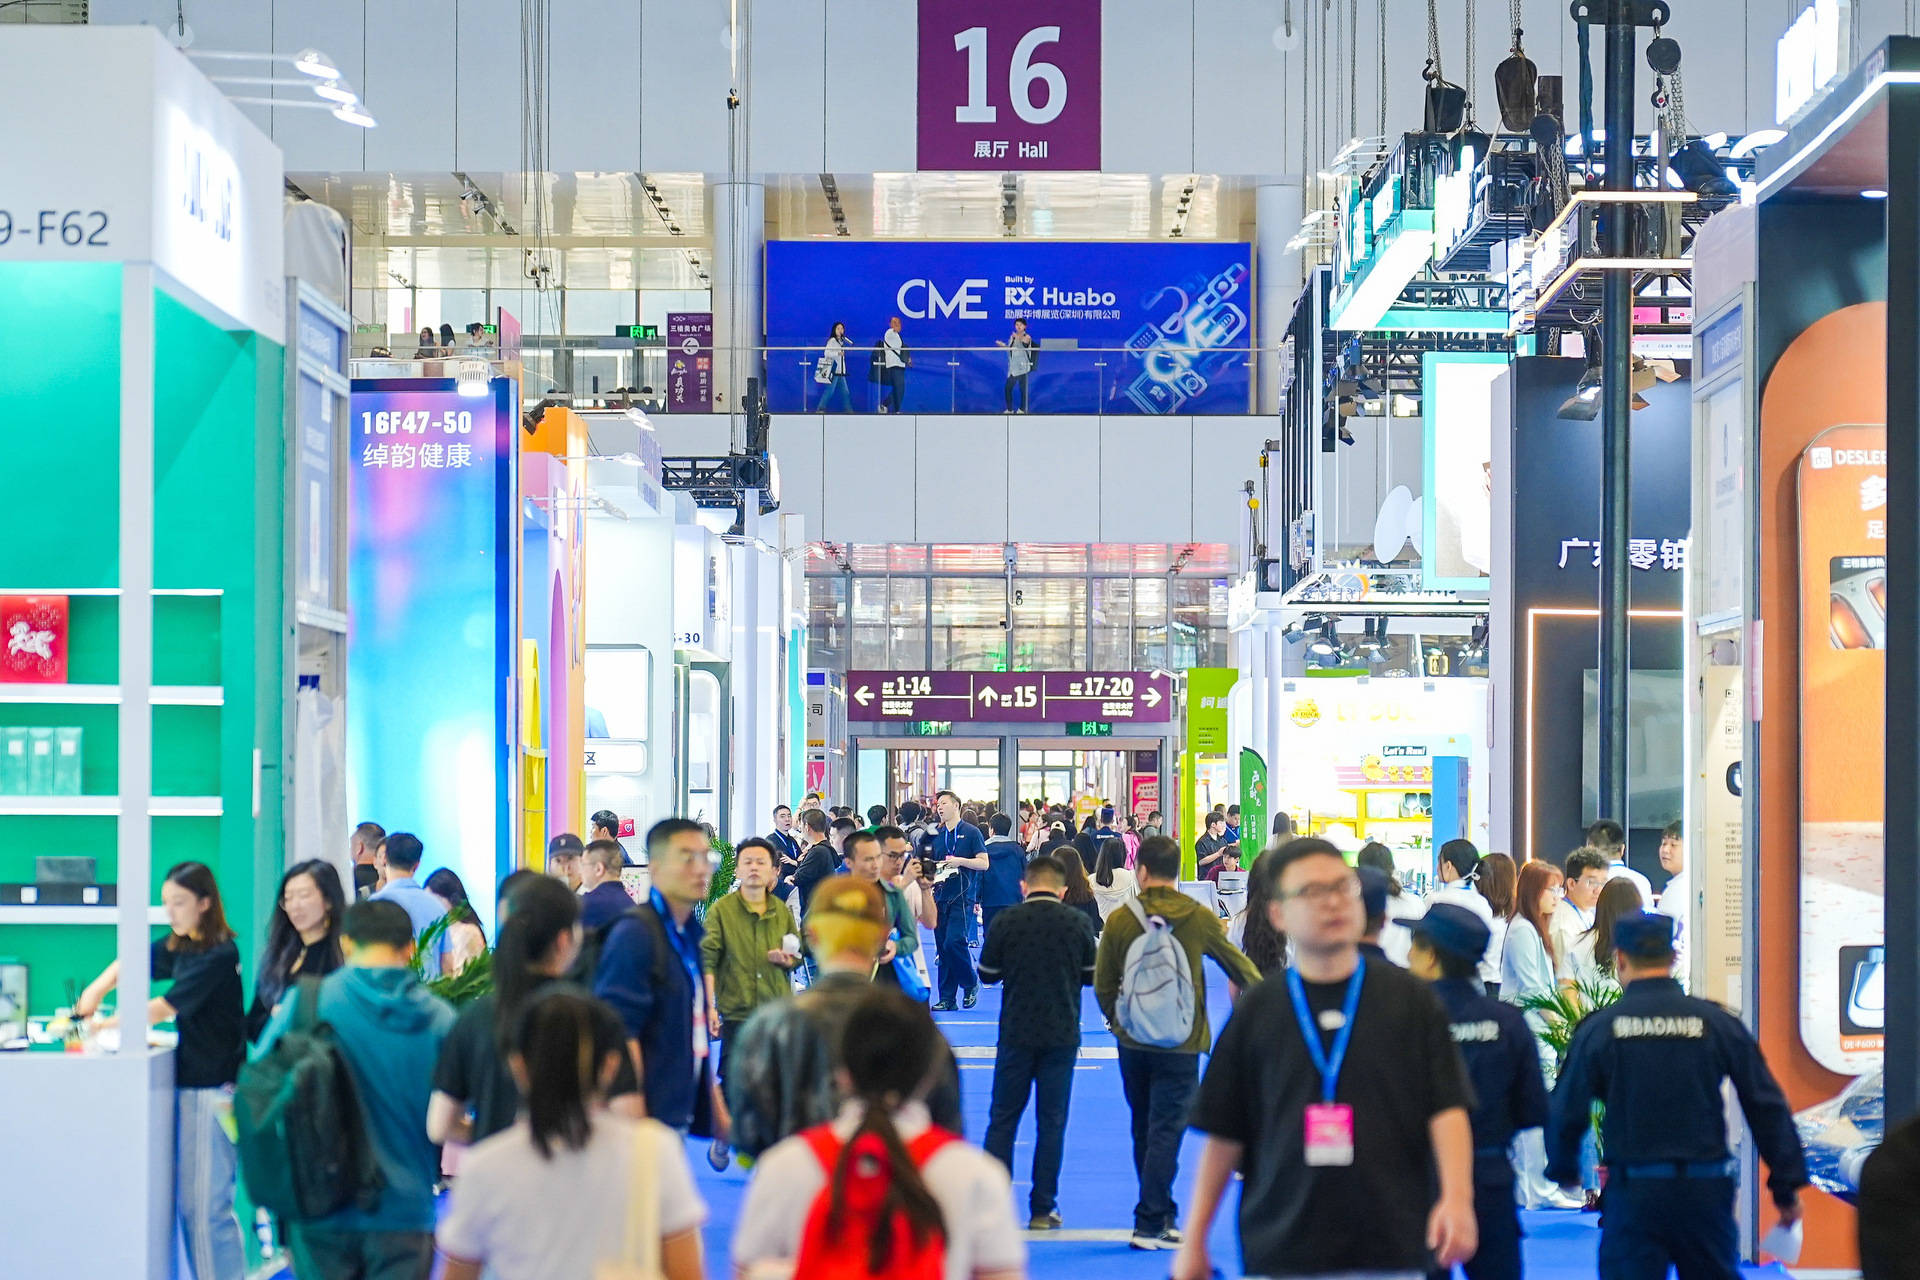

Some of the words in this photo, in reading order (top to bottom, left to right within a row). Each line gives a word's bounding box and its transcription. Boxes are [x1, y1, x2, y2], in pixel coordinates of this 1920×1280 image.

[954, 26, 1068, 124] 16
[973, 141, 1009, 159] 展厅
[1018, 142, 1048, 158] Hall
[1024, 276, 1035, 284] by
[896, 278, 988, 319] CME
[1005, 287, 1035, 306] RX
[1042, 288, 1116, 306] Huabo
[362, 411, 472, 434] 16F47-50
[362, 442, 473, 469] 绰韵健康
[896, 676, 932, 695] 1-14
[1084, 676, 1134, 696] 17-20
[1014, 685, 1038, 708] 15
